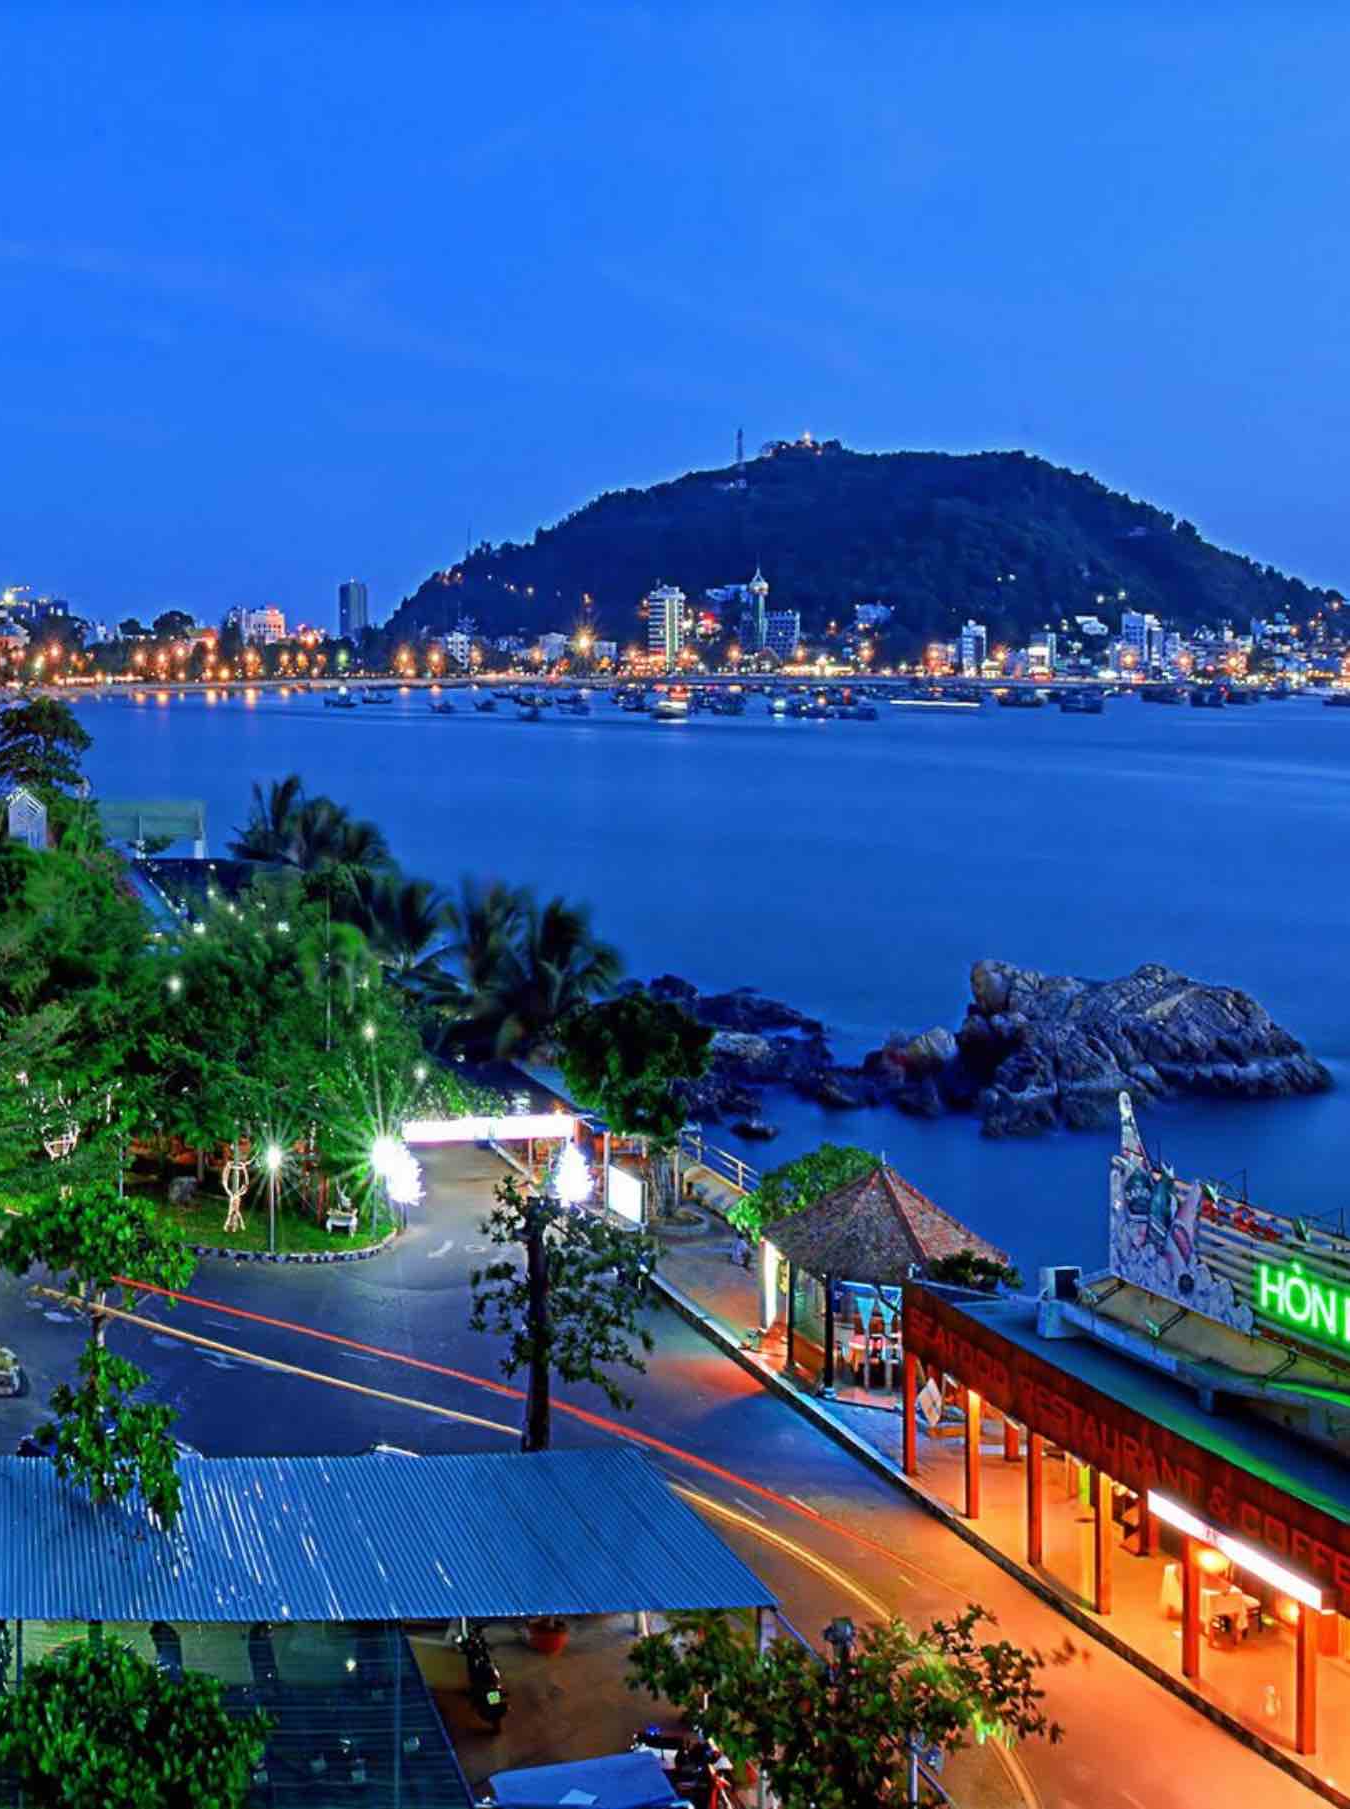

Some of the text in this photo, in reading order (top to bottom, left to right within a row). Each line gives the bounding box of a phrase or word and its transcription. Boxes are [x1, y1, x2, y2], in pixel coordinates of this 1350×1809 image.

[1259, 1261, 1337, 1335] HÒN
[906, 1304, 1010, 1396] SEAFOOD
[1017, 1373, 1202, 1503] RESTAURANT
